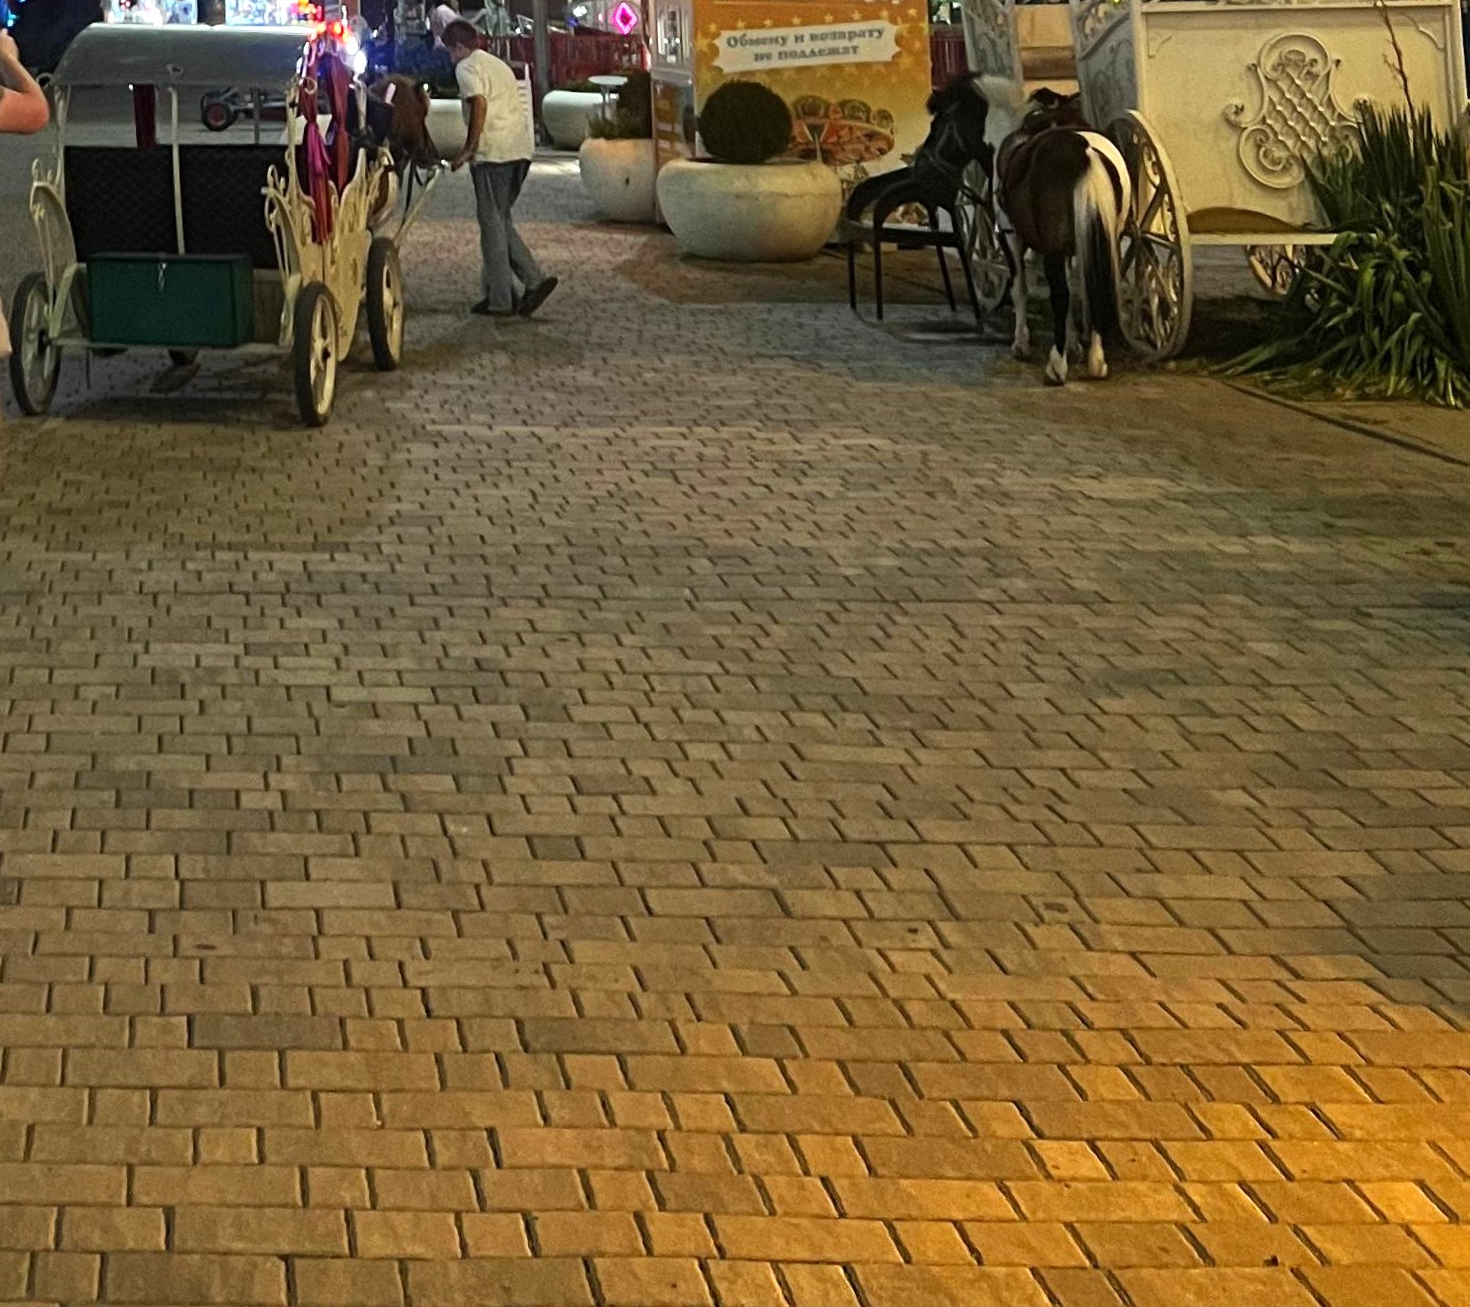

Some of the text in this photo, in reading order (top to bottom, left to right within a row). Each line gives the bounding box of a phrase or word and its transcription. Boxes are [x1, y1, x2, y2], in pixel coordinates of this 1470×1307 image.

[726, 27, 885, 49] Обмену и возврату
[754, 45, 860, 62] не подлежат
